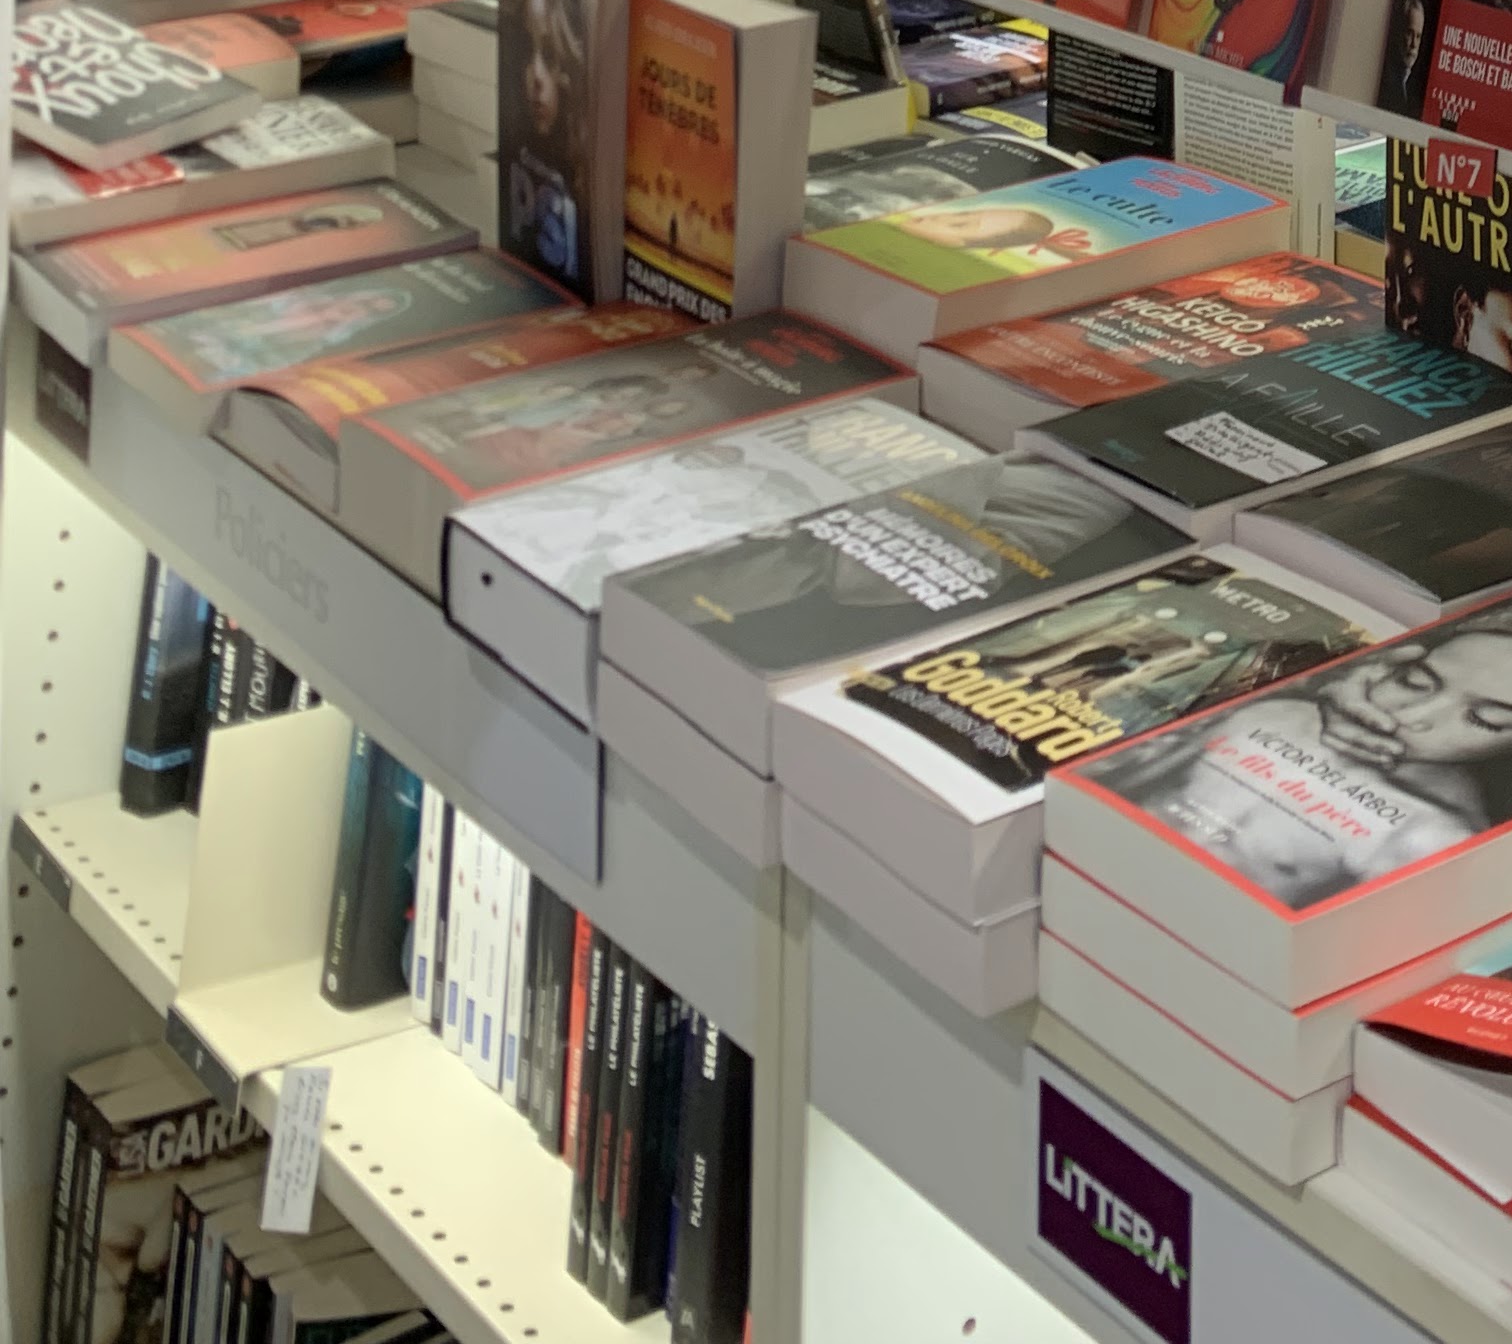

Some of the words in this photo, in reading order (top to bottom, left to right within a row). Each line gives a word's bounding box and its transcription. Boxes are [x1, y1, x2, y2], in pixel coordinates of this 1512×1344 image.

[1443, 25, 1462, 50] UNE
[1463, 31, 1512, 65] NOUVELLE
[1438, 49, 1452, 71] DE
[1453, 53, 1486, 82] BOSCH
[1486, 62, 1501, 87] ET
[1437, 152, 1482, 190] N°7
[1111, 297, 1265, 359] HIGASHINO
[1174, 296, 1267, 337] KEIGO
[214, 486, 332, 627] Policiers
[901, 648, 1128, 763] Goddard
[1237, 753, 1277, 781] fils
[1276, 779, 1315, 803] du
